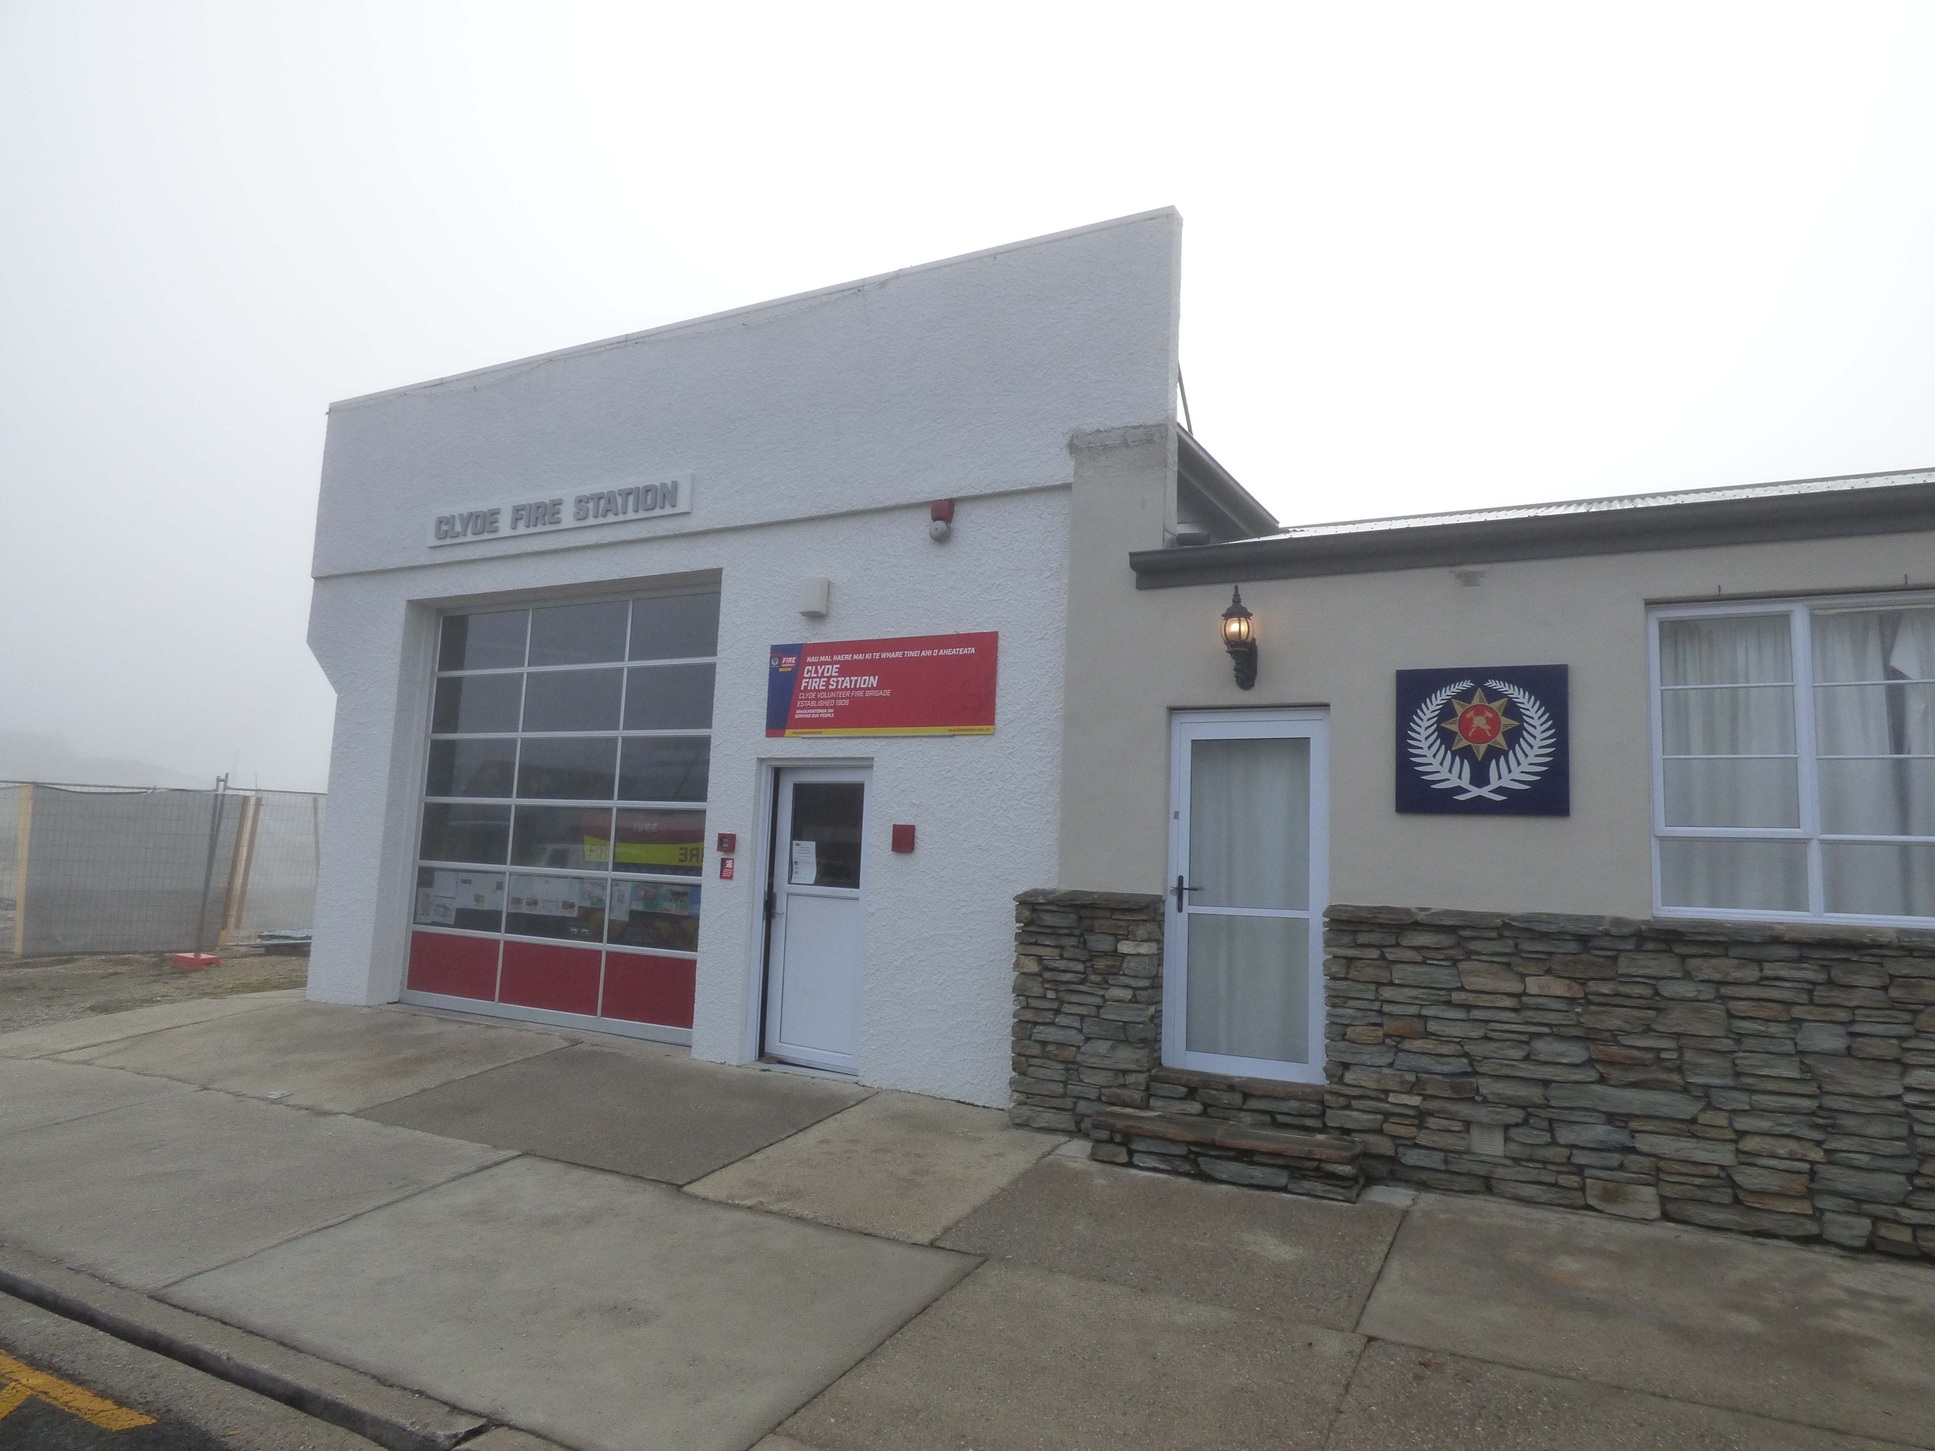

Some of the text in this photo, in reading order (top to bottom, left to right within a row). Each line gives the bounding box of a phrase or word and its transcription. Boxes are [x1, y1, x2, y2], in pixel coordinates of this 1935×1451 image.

[434, 480, 678, 540] CLYDE FIRE STATION
[782, 656, 796, 664] FIRE
[881, 651, 903, 659] WHARE
[804, 664, 840, 677] CLYDE
[801, 676, 878, 690] FIRE STATION
[817, 690, 850, 698] VOLUNTEER
[865, 689, 891, 697] BRIGADE
